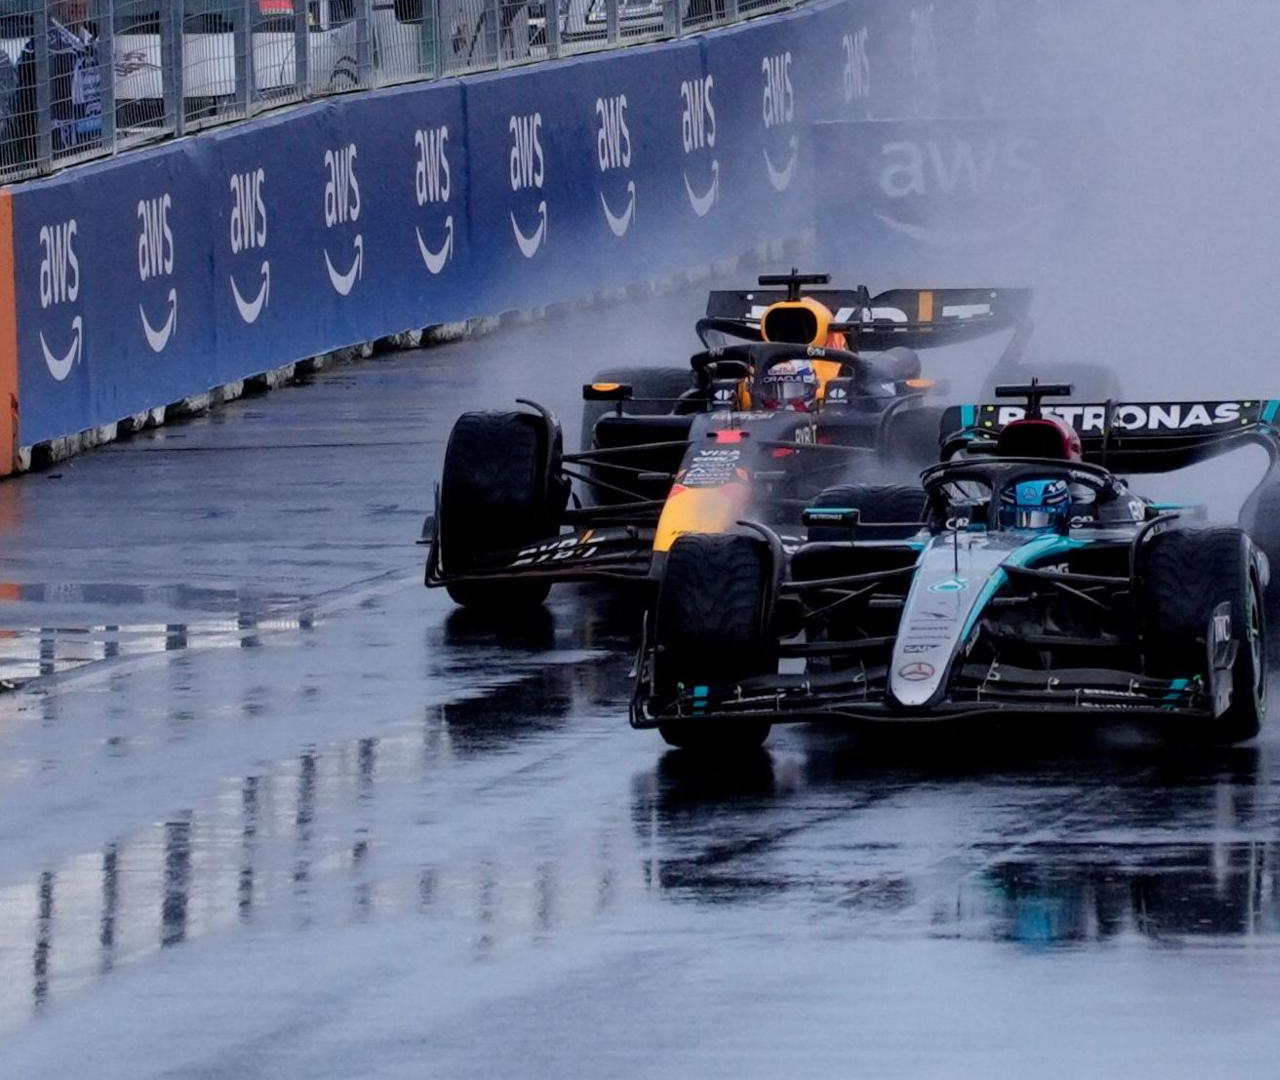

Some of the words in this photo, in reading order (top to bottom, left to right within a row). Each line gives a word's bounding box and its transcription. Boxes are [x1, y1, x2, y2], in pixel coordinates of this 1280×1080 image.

[680, 74, 717, 154] aws
[762, 50, 794, 129] aws
[414, 125, 450, 207] aws
[509, 112, 545, 192] aws
[595, 93, 632, 173] aws
[230, 167, 267, 254] aws
[323, 143, 361, 228] aws
[39, 218, 80, 310] aws
[137, 192, 174, 282] aws
